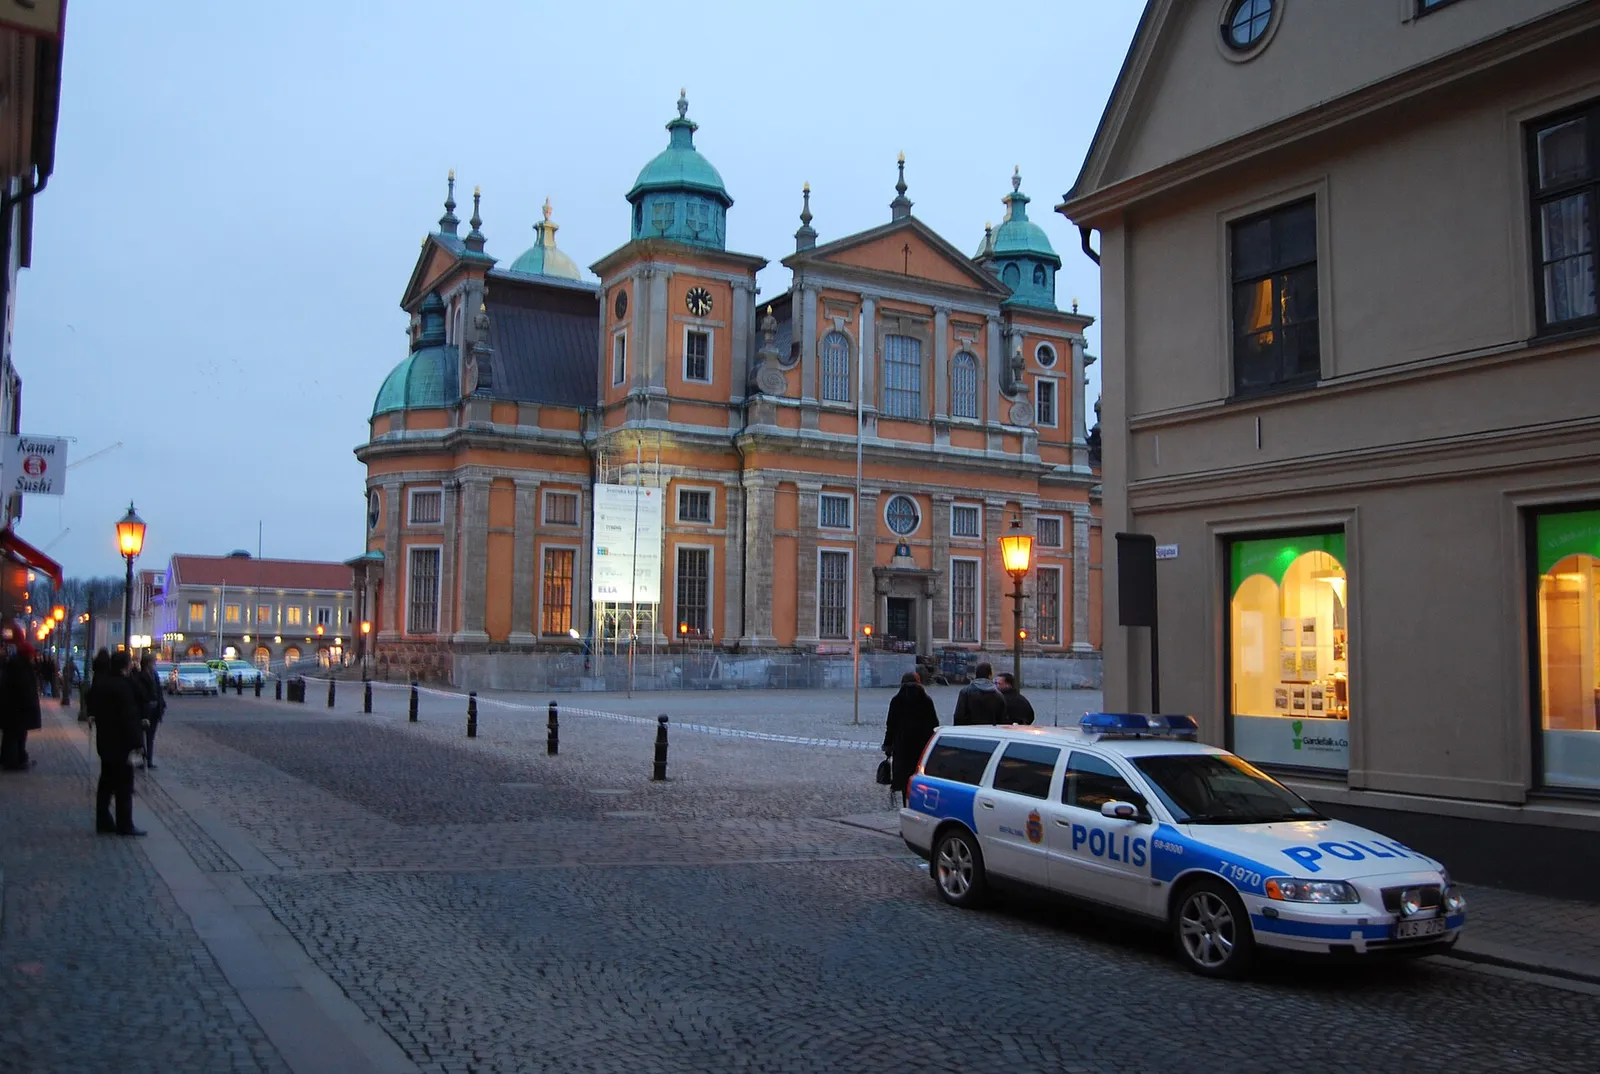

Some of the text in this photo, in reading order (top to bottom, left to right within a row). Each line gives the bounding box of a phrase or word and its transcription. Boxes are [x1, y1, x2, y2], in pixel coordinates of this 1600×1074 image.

[17, 438, 56, 454] Kama
[15, 476, 52, 492] Sushi
[1072, 823, 1147, 867] POLIS
[1219, 861, 1261, 887] 7 1970
